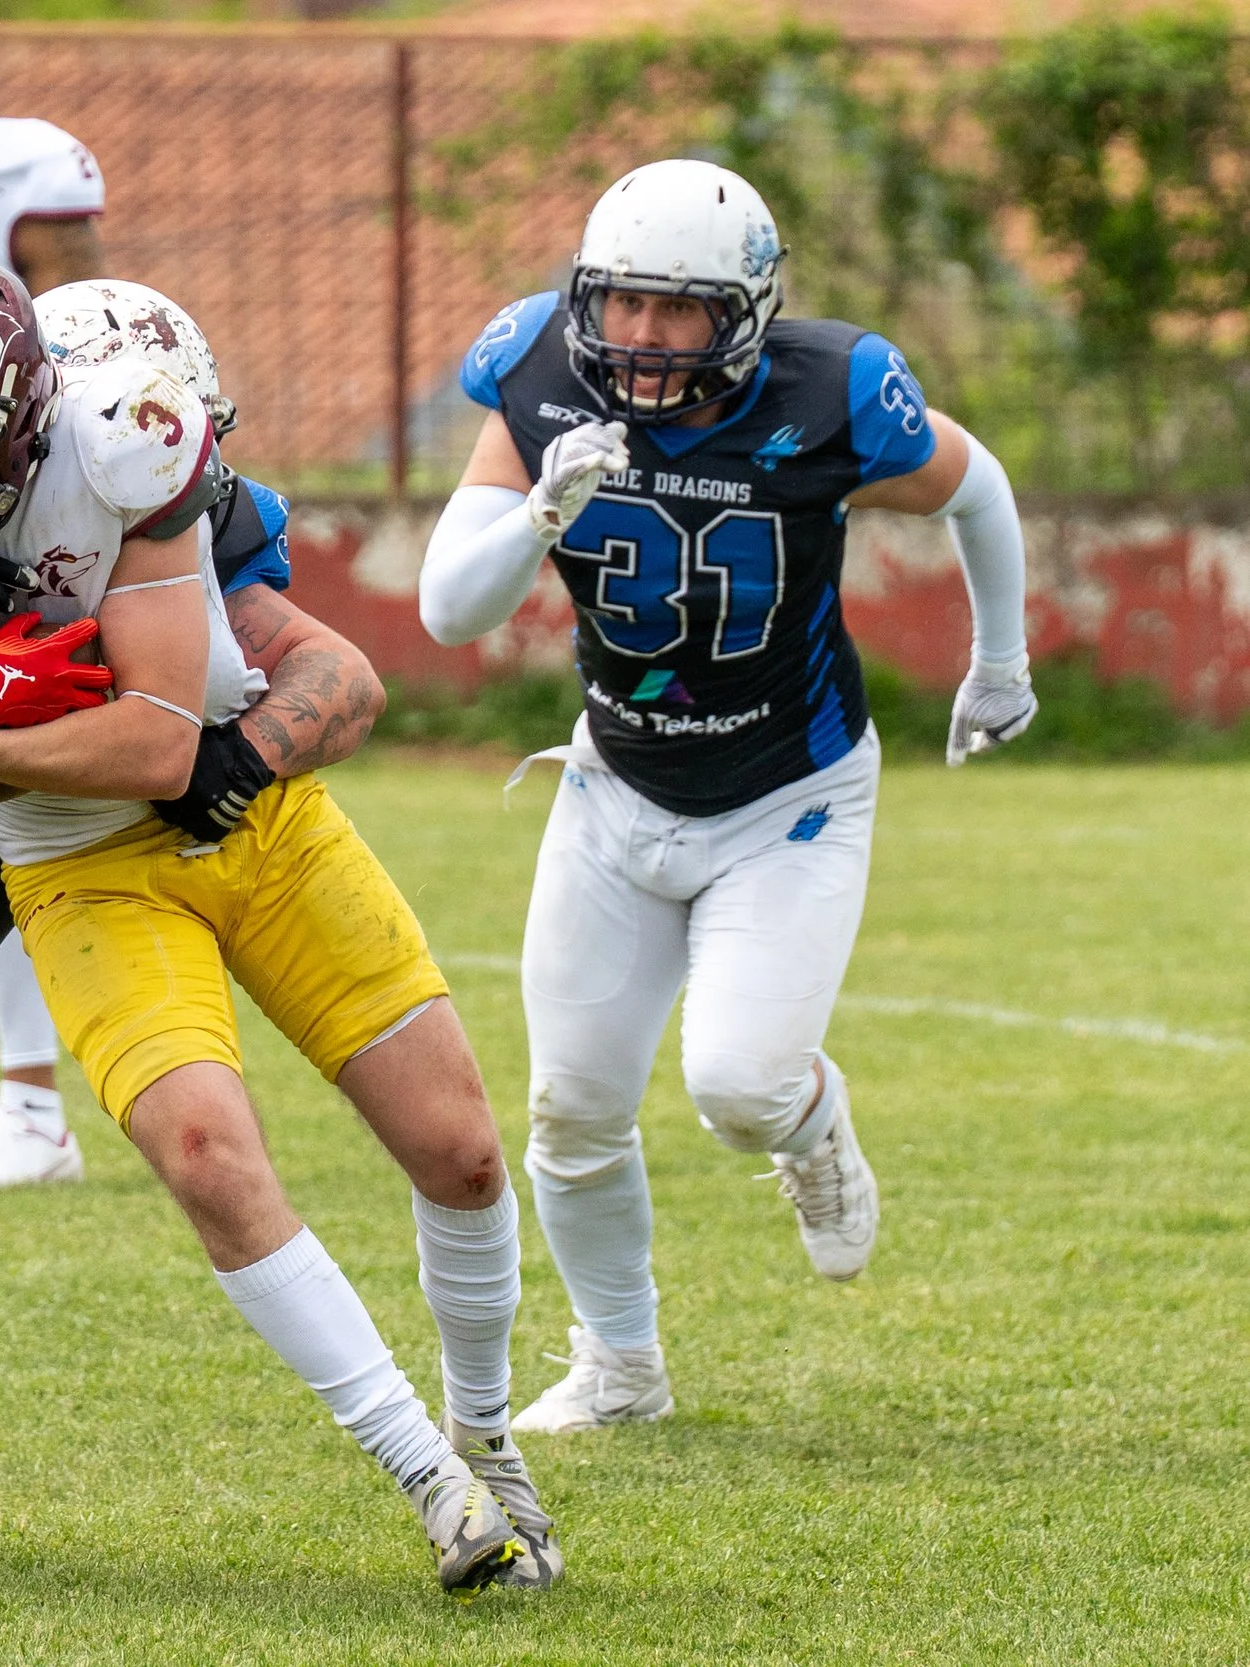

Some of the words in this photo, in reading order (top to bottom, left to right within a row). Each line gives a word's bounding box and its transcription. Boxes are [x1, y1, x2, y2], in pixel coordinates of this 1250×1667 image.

[137, 400, 184, 447] 3
[598, 467, 643, 491] LUE
[653, 471, 753, 505] DRAGONS
[554, 490, 787, 662] 31
